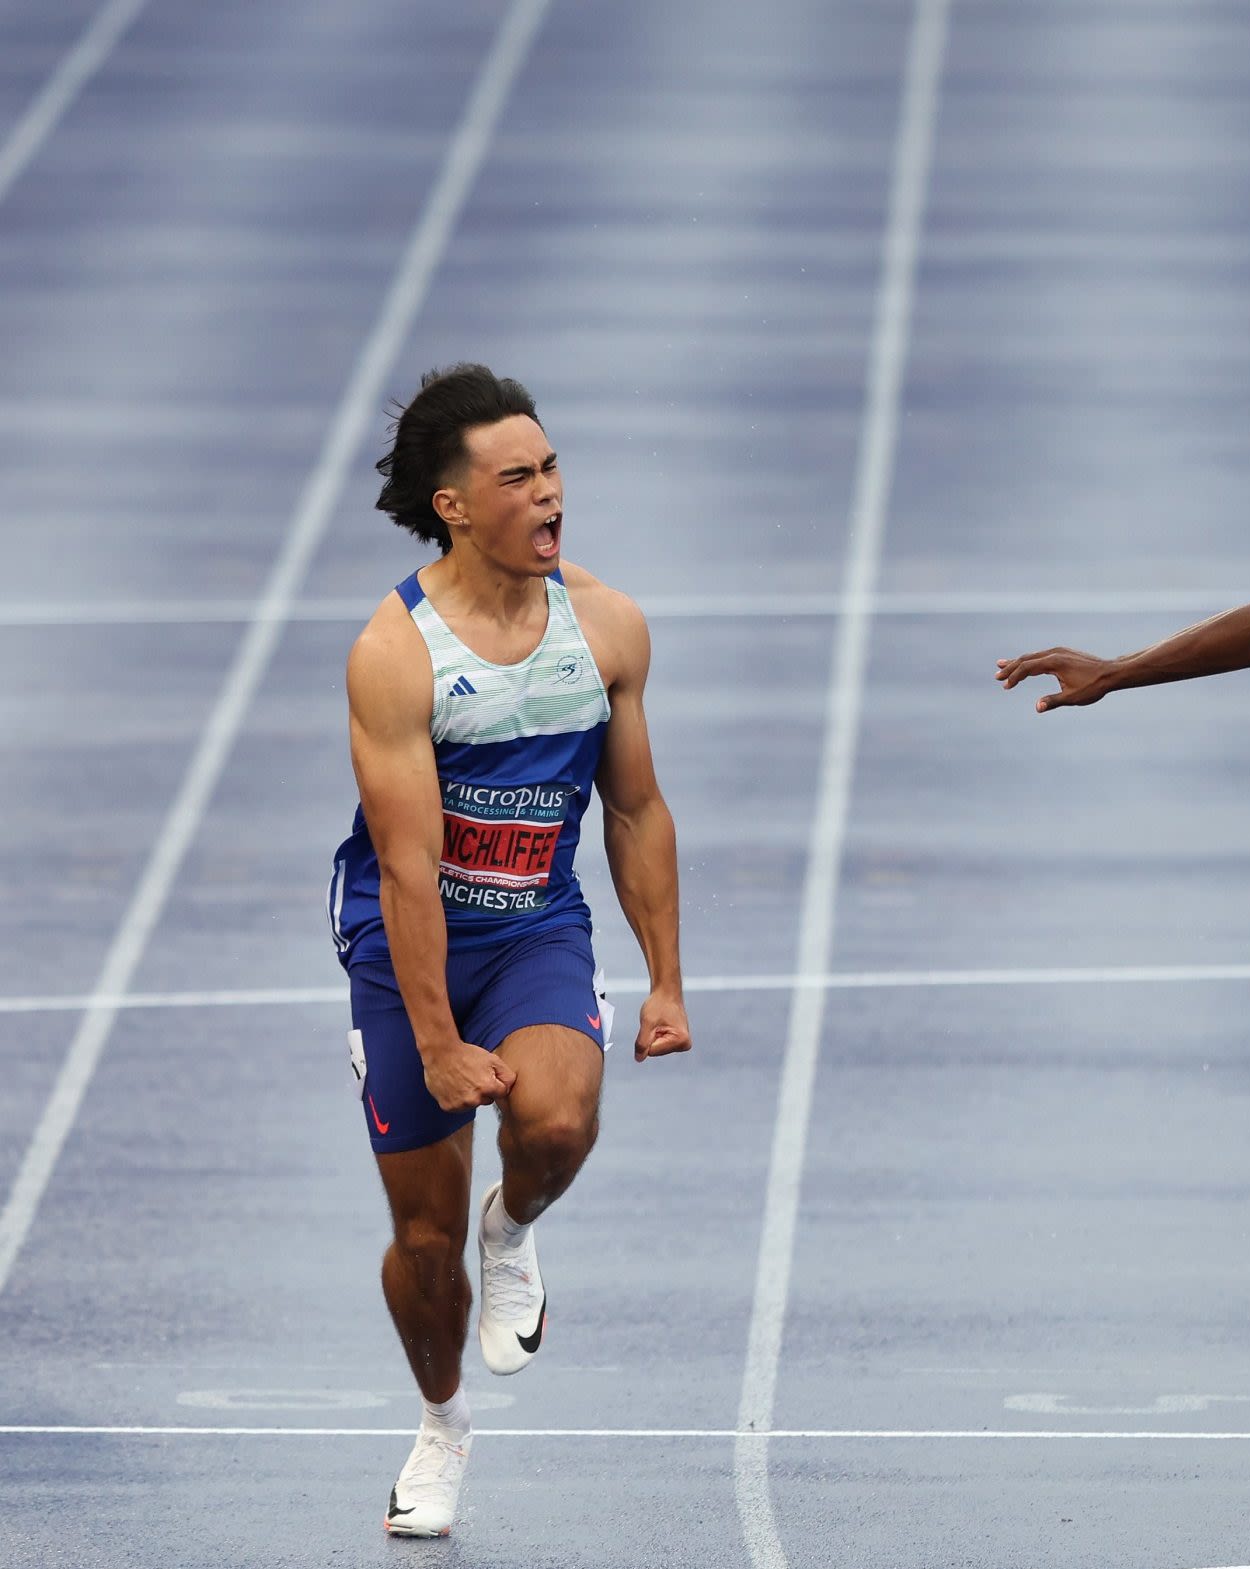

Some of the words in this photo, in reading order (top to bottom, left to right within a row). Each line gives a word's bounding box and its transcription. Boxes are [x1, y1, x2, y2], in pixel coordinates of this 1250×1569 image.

[457, 801, 515, 816] PROCESSING
[529, 808, 560, 818] TIMING
[444, 820, 556, 870] NCHLIFFE
[440, 880, 536, 910] NCHESTER
